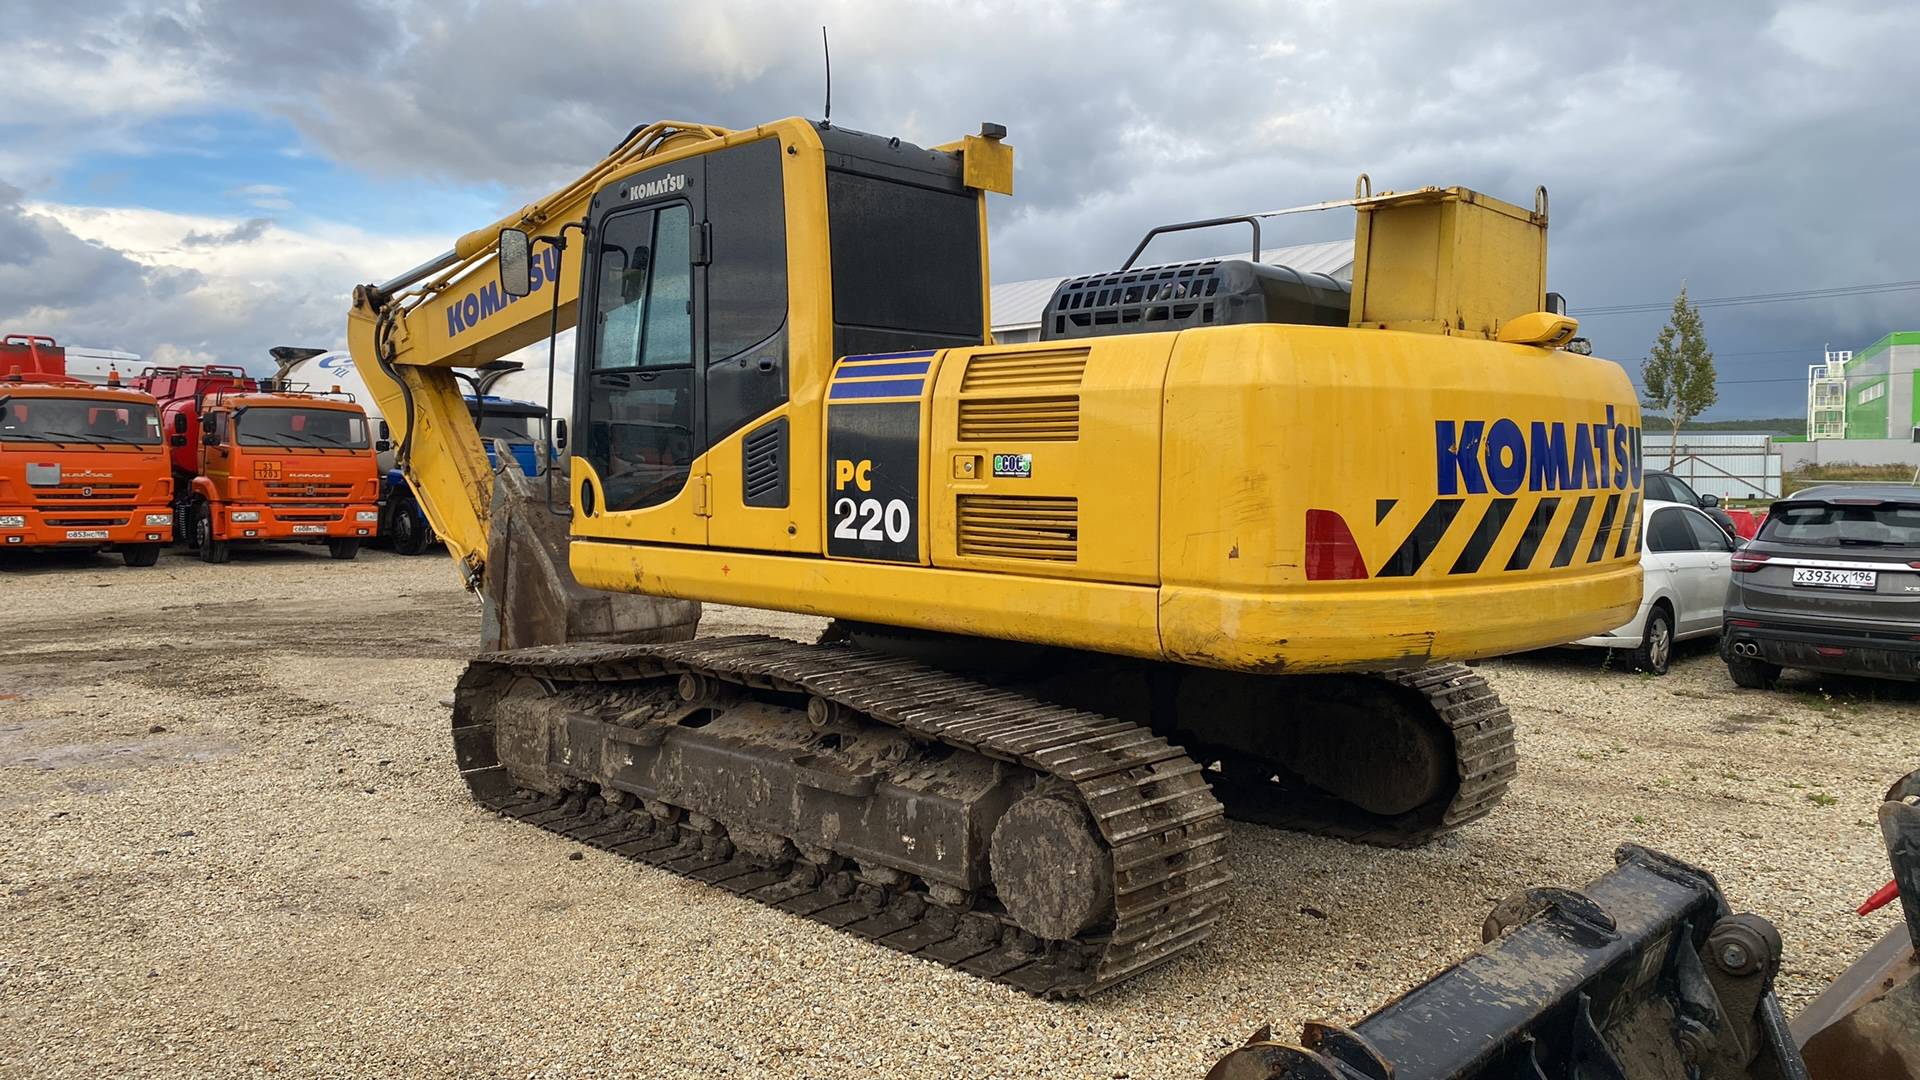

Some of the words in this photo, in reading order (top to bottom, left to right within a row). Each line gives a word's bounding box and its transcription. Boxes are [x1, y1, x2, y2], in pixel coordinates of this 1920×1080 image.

[630, 173, 685, 200] KOMATSU
[446, 246, 561, 338] KOMSU
[1435, 404, 1643, 496] KOMATSU
[258, 470, 278, 478] 1203
[263, 462, 273, 470] 33
[836, 459, 872, 491] PC
[834, 498, 910, 542] 220
[1852, 571, 1873, 582] 196
